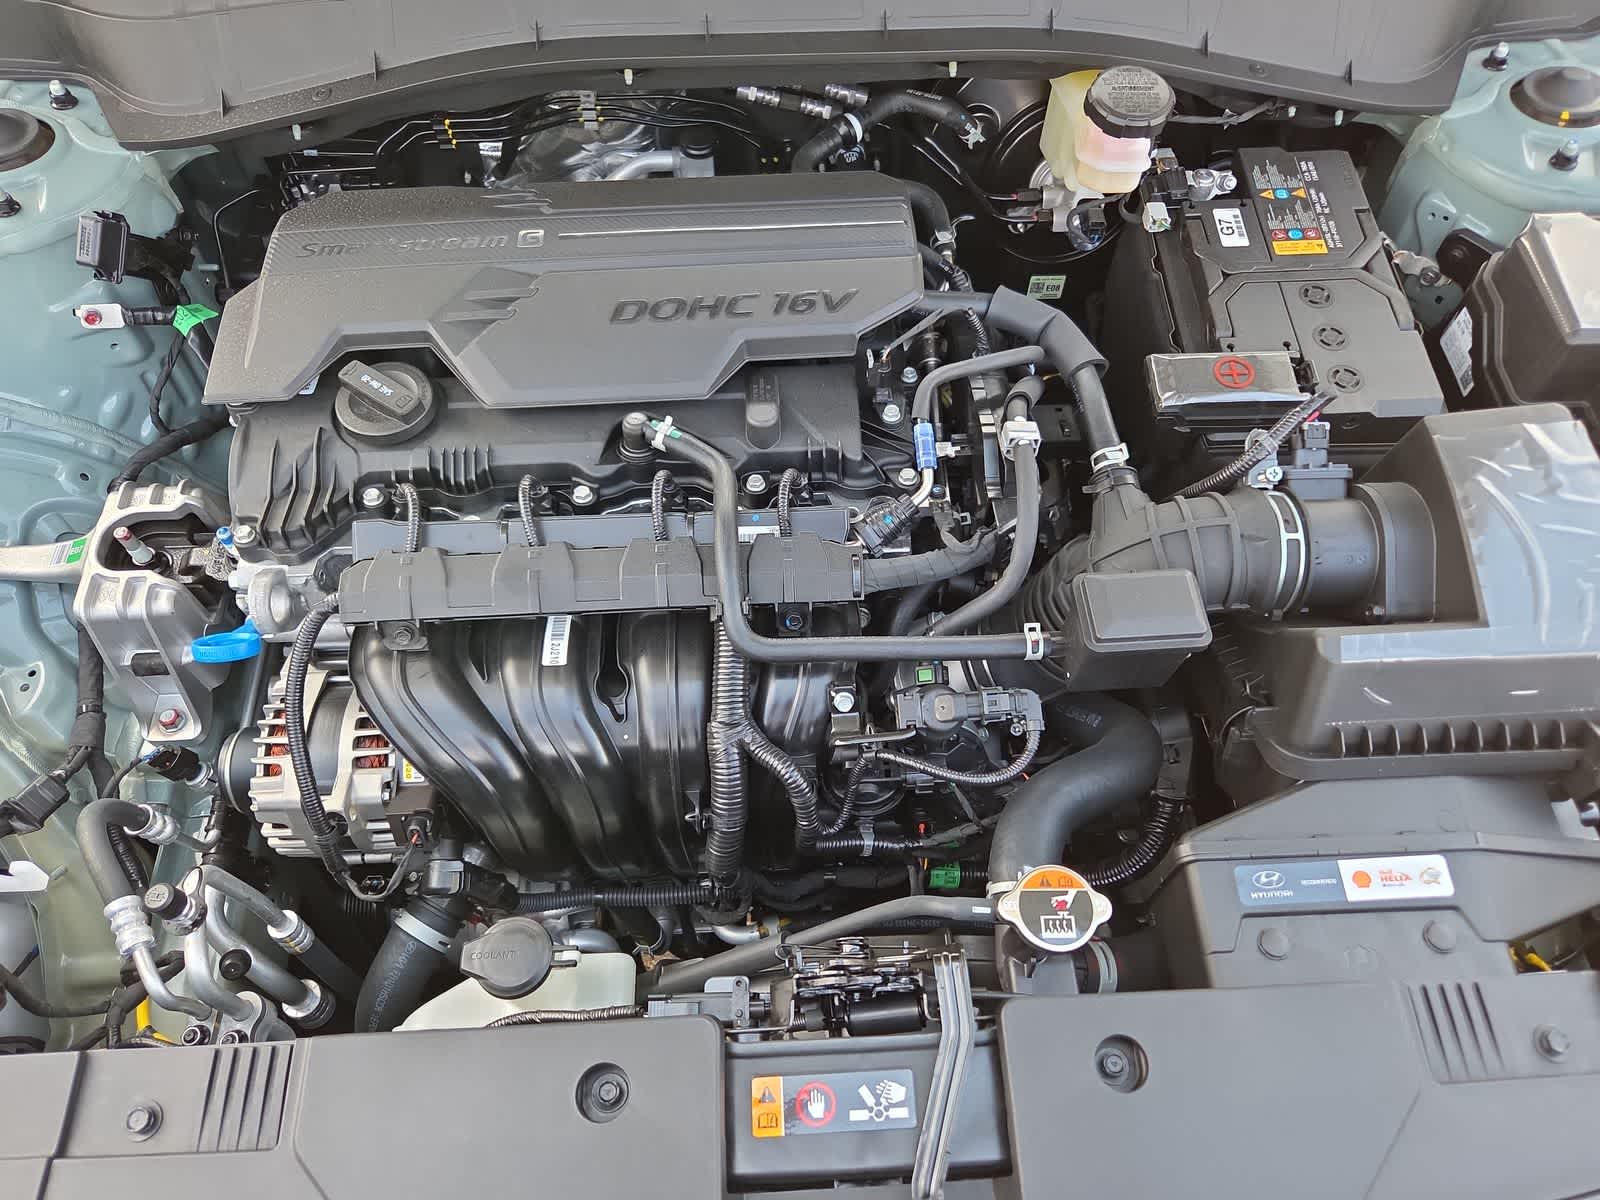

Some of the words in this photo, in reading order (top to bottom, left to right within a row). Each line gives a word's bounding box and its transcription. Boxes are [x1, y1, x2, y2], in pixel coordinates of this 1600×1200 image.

[1218, 218, 1235, 236] G7
[609, 292, 761, 324] DOHC
[772, 287, 861, 317] 16V
[470, 950, 517, 961] COOLANT
